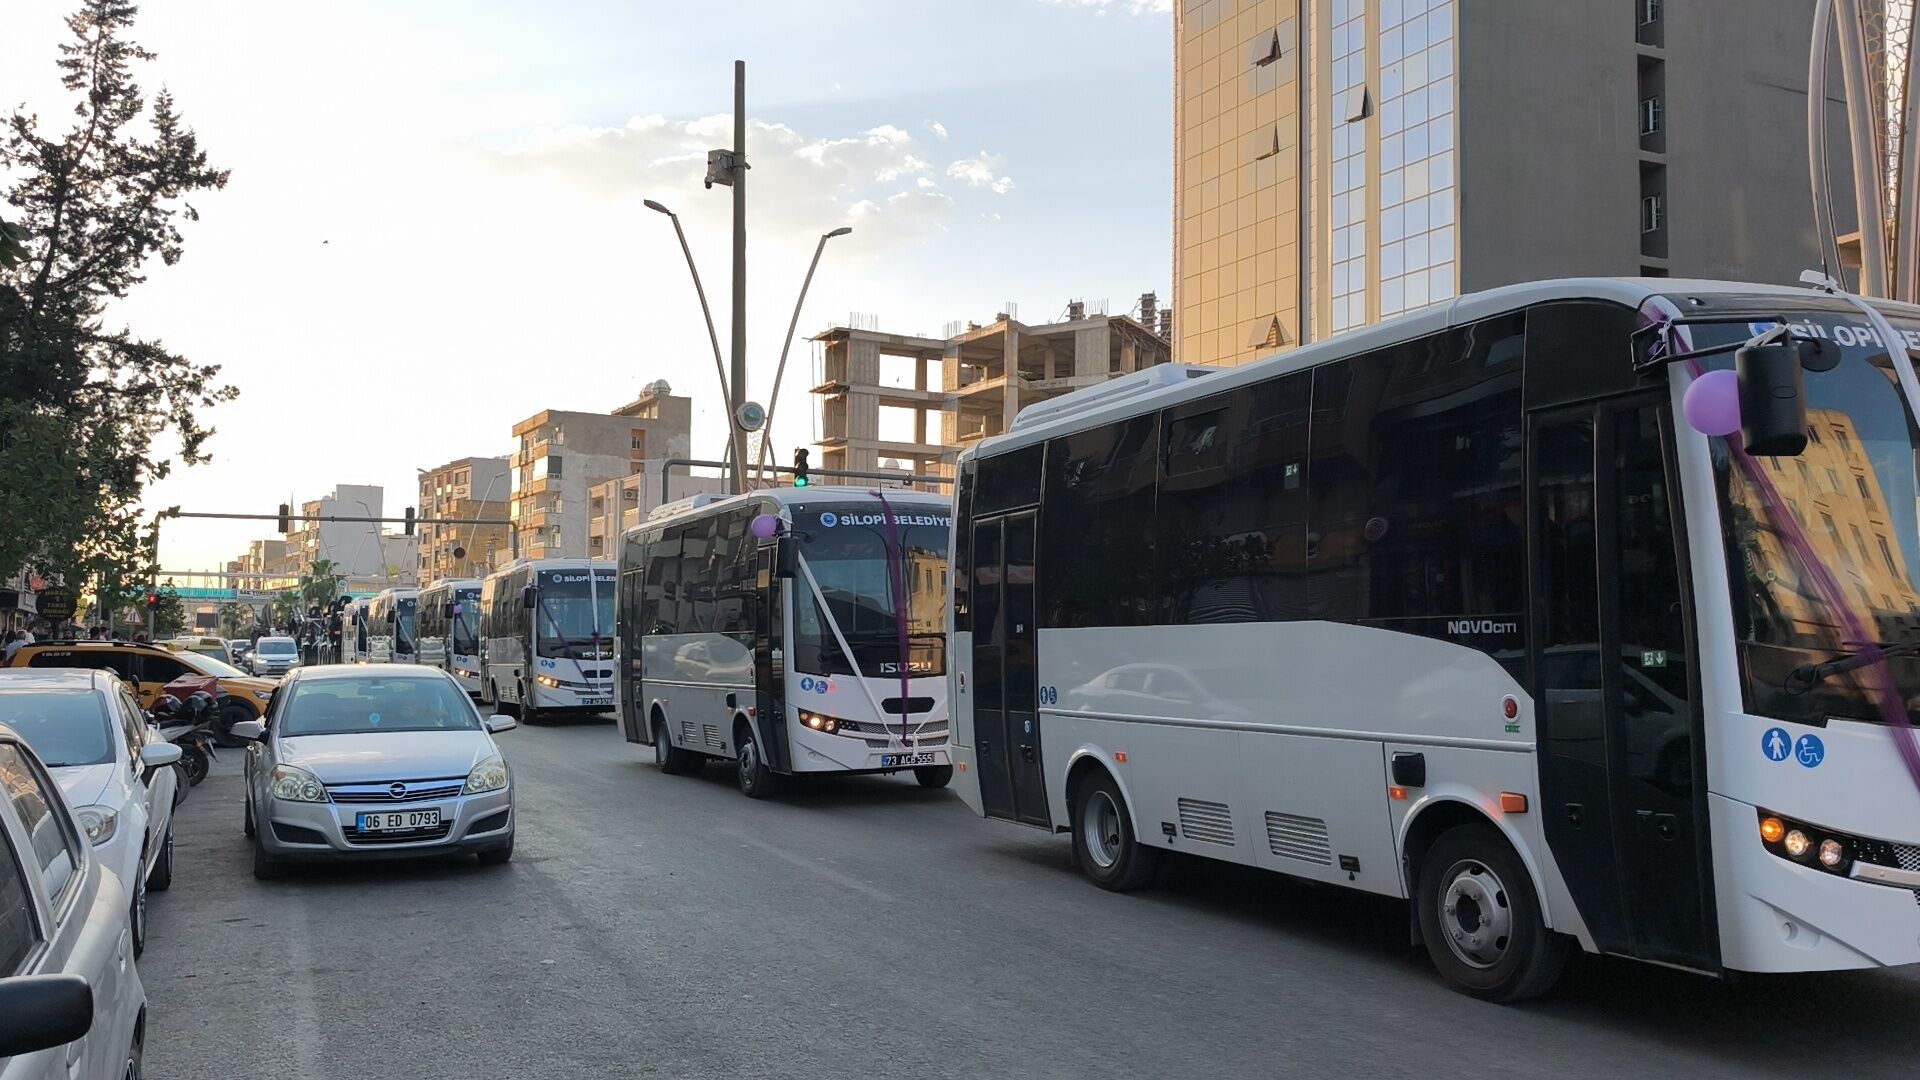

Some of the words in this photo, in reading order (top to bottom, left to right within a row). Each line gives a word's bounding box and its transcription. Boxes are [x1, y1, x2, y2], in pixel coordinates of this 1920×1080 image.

[841, 513, 887, 526] SİLOPİ
[880, 661, 932, 673] ISUZU
[886, 755, 897, 766] 73
[917, 753, 932, 764] 555
[365, 815, 380, 828] 06
[387, 814, 402, 827] ED
[410, 811, 438, 825] 0793
